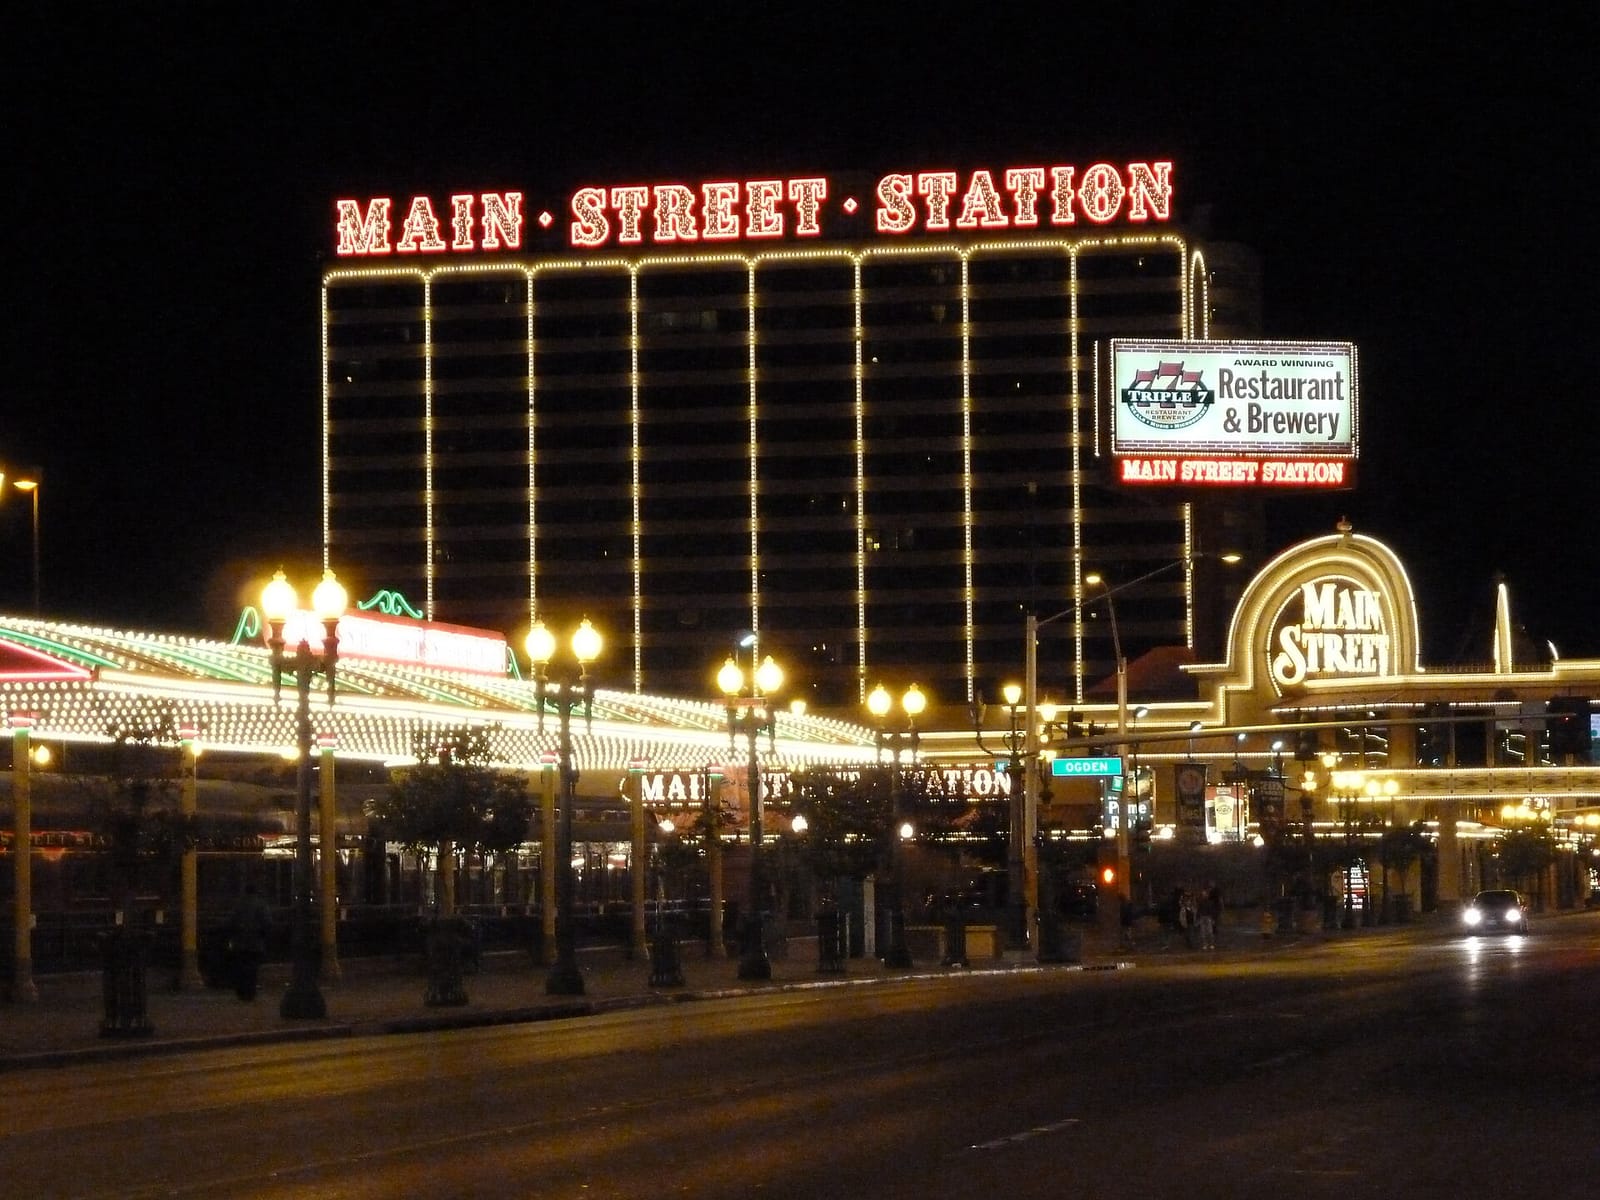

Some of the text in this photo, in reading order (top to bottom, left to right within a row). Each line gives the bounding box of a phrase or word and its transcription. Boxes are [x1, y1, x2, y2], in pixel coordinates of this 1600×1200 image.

[336, 161, 1173, 255] MAIN STREET STATION
[1234, 358, 1335, 368] AWARD WINNING
[1127, 390, 1209, 404] TRIPLE 7
[1218, 367, 1345, 401] Restaurant
[1222, 407, 1242, 434] &
[1247, 402, 1340, 441] Brewery
[1121, 459, 1344, 483] MAIN STREET STATION
[1301, 583, 1380, 630] MAIN
[1273, 624, 1389, 685] STREET
[1065, 762, 1109, 773] OGDEN
